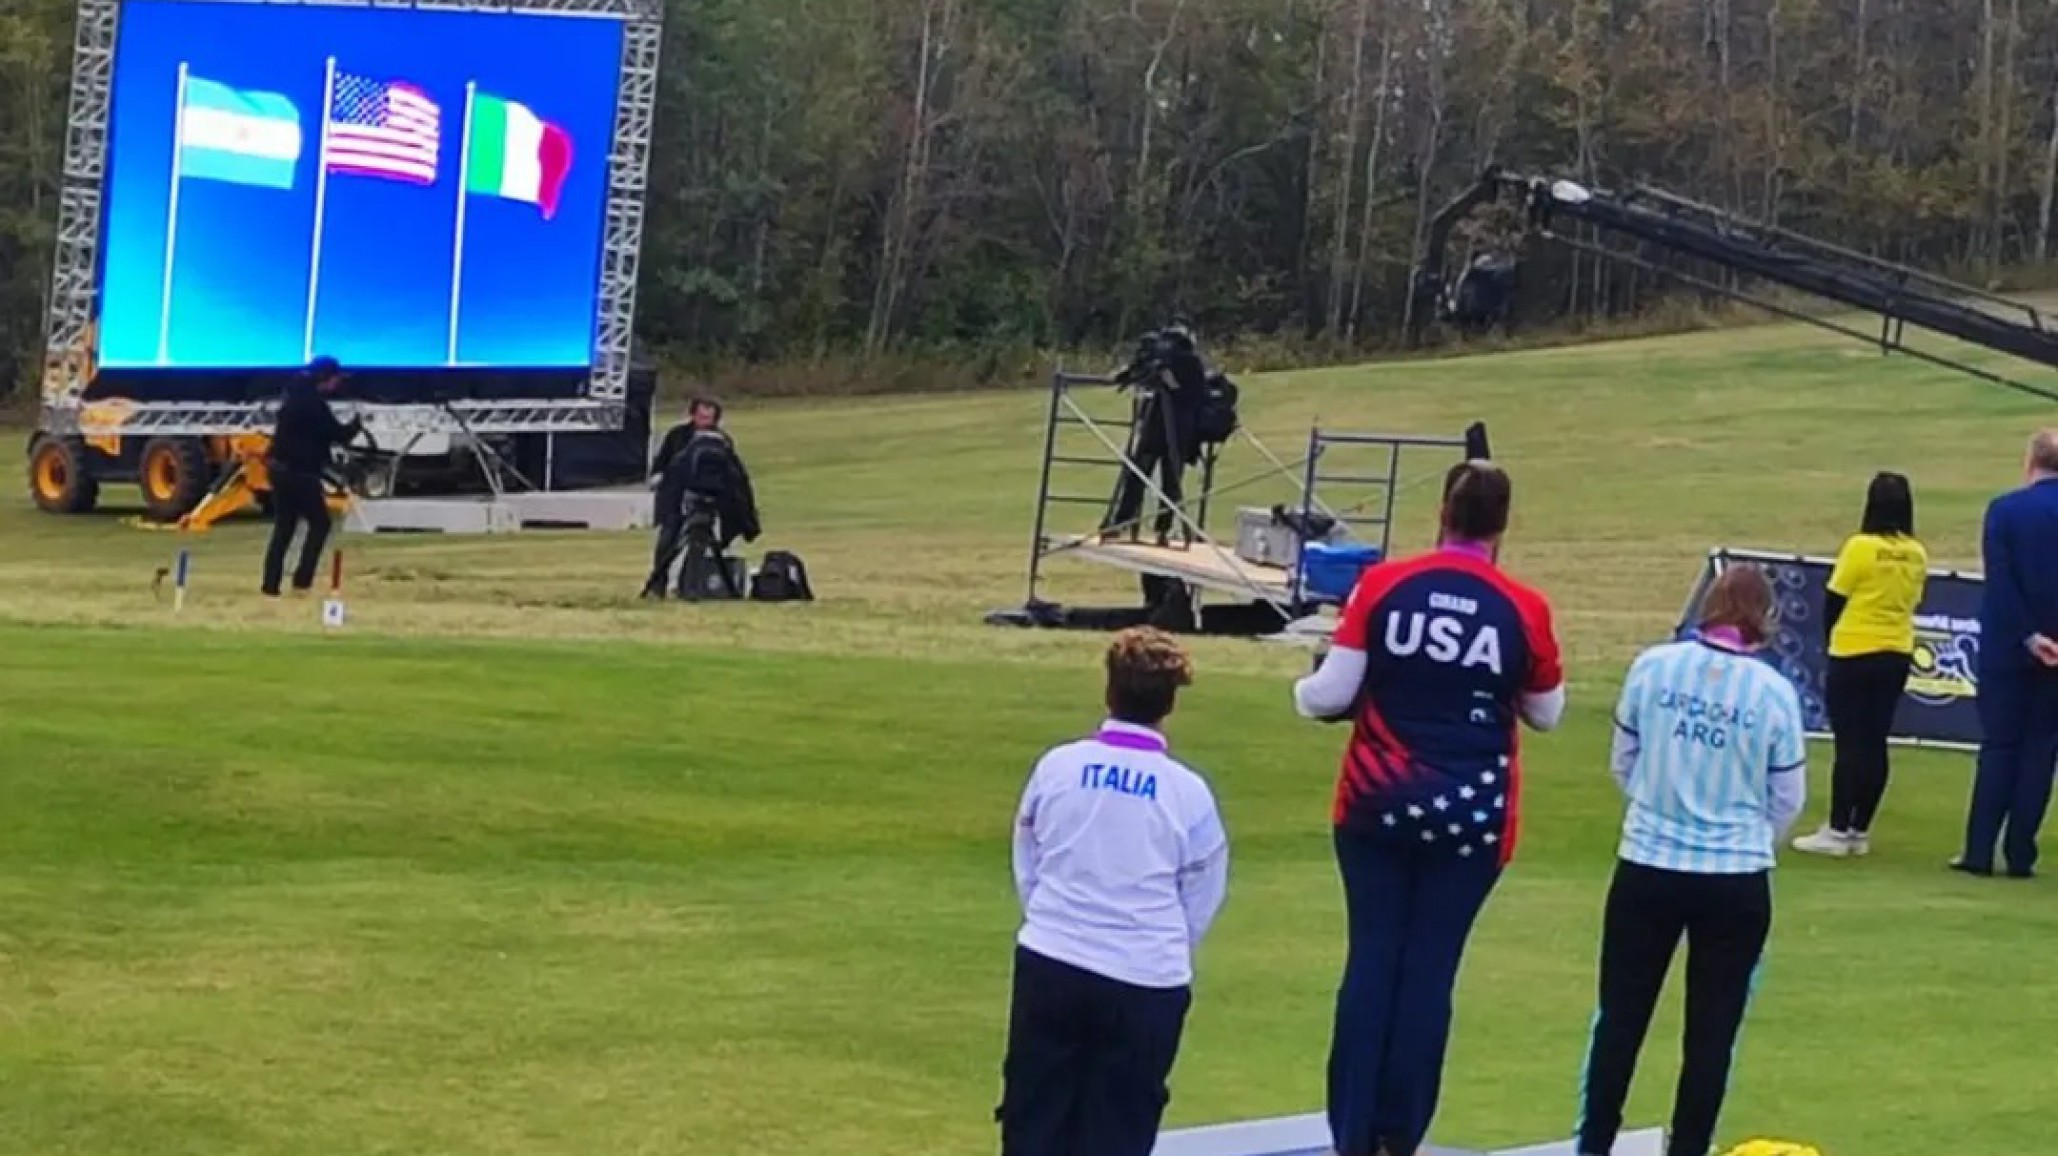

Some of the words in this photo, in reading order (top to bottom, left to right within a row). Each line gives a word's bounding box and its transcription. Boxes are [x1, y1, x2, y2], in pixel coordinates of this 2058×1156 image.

[1385, 610, 1502, 675] USA
[1673, 720, 1726, 749] ARG
[1081, 764, 1157, 801] ITALIA
